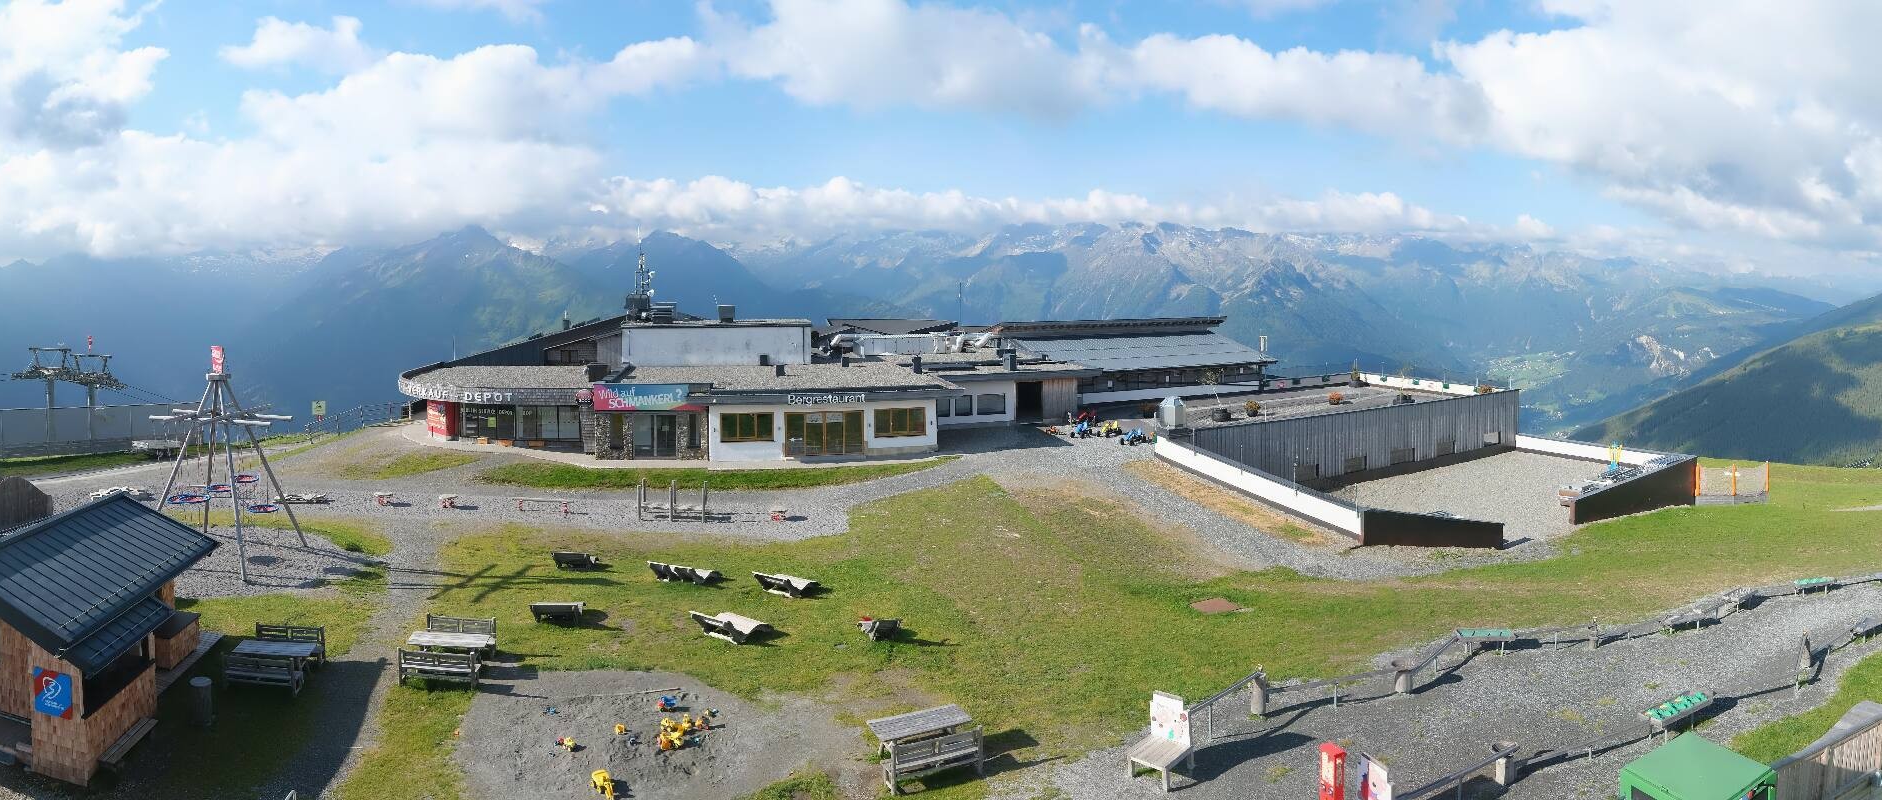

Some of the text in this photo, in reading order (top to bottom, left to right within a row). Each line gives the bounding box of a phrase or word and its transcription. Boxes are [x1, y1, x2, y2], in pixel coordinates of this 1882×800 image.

[408, 384, 513, 402] VERKAUF DEPOT
[598, 389, 619, 400] Wild
[620, 387, 636, 398] auf
[788, 393, 866, 406] Bergrestaurant
